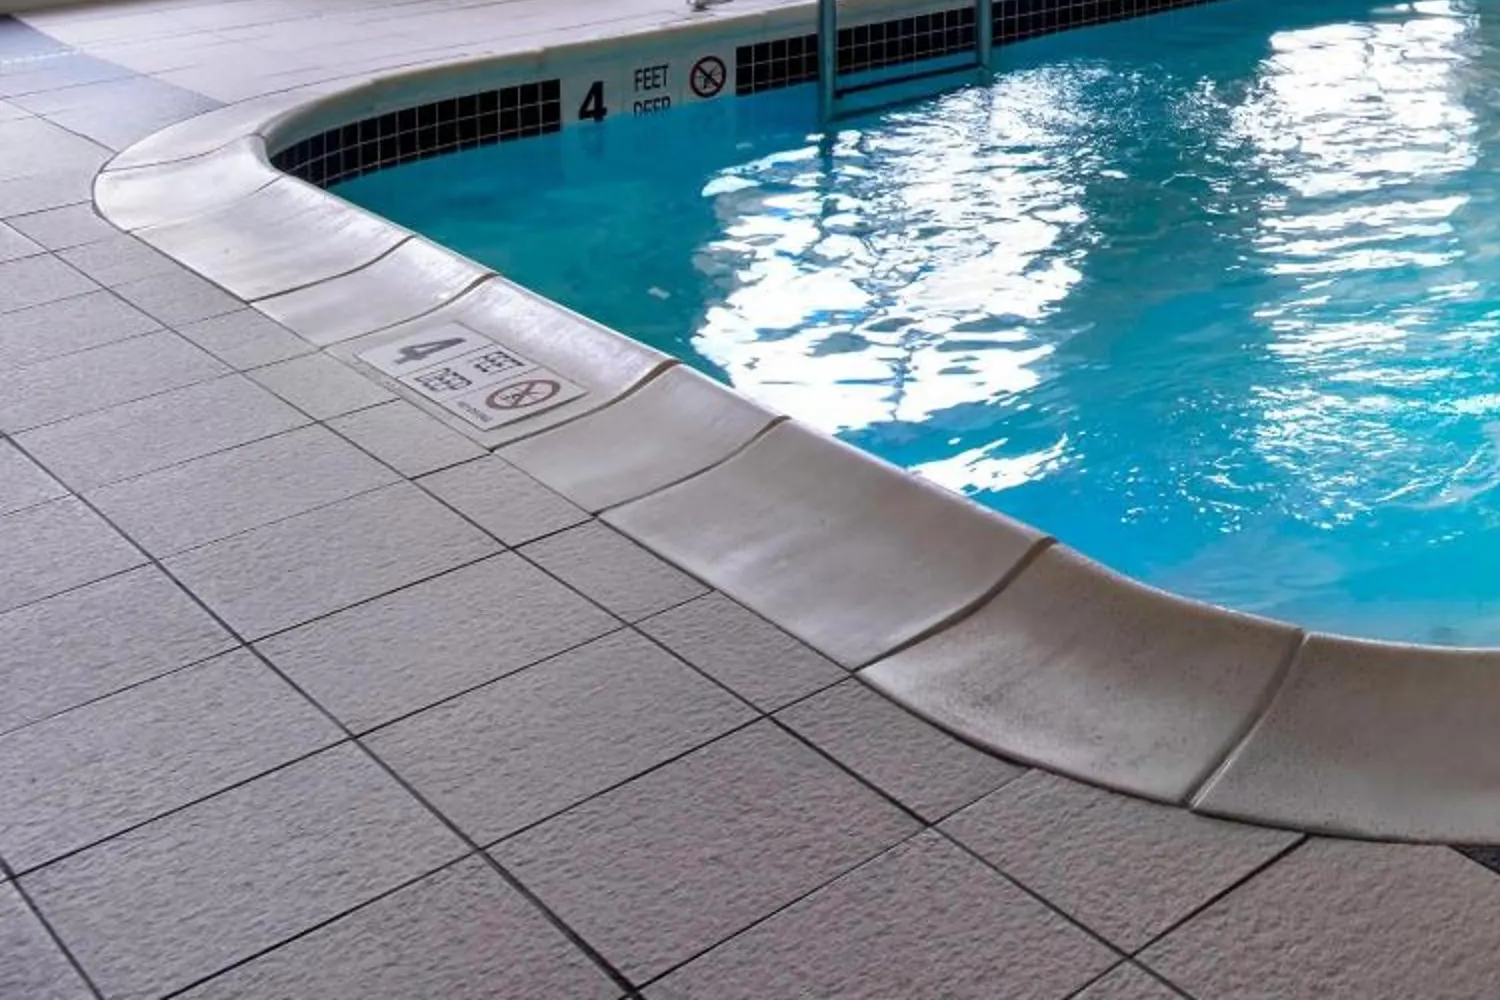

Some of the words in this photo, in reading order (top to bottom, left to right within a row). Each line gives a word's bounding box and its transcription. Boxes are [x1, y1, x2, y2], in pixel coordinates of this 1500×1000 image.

[633, 62, 670, 92] FEET
[578, 80, 607, 122] 4
[393, 337, 467, 364] 4
[470, 350, 526, 375] FEET
